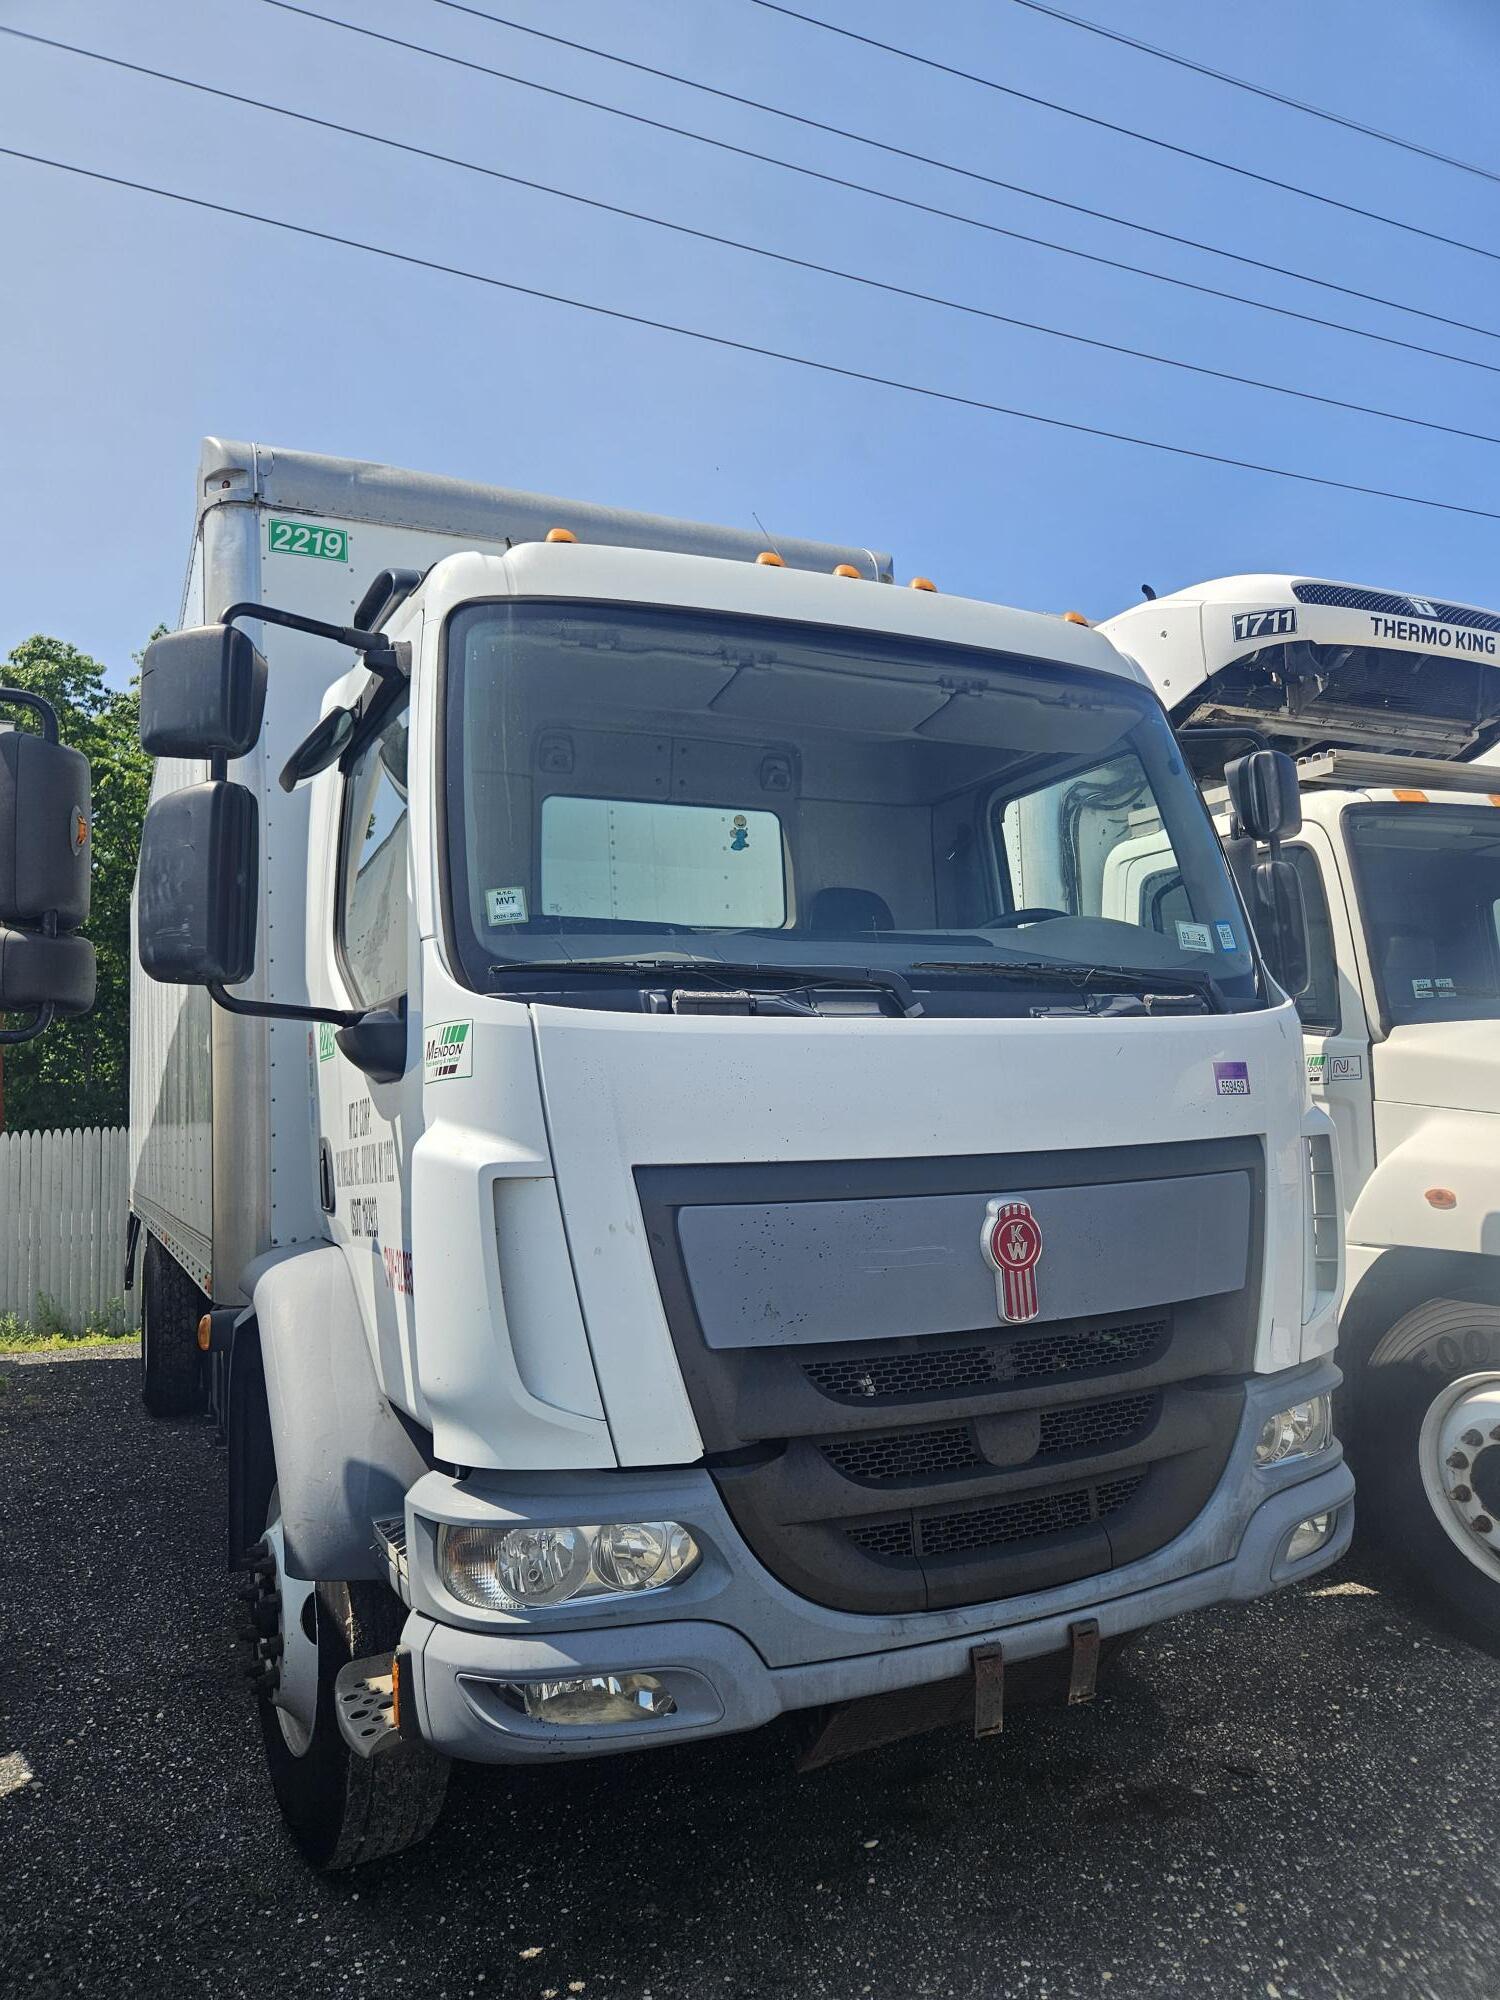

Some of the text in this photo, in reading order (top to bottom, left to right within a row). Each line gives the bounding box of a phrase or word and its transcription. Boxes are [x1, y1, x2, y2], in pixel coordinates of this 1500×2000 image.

[273, 524, 343, 557] 2219
[1236, 611, 1293, 639] 1711
[1370, 616, 1496, 655] THERMO KING
[495, 896, 516, 905] MVT
[426, 1040, 464, 1061] MENDON
[1010, 1224, 1025, 1242] K
[1007, 1241, 1028, 1260] W
